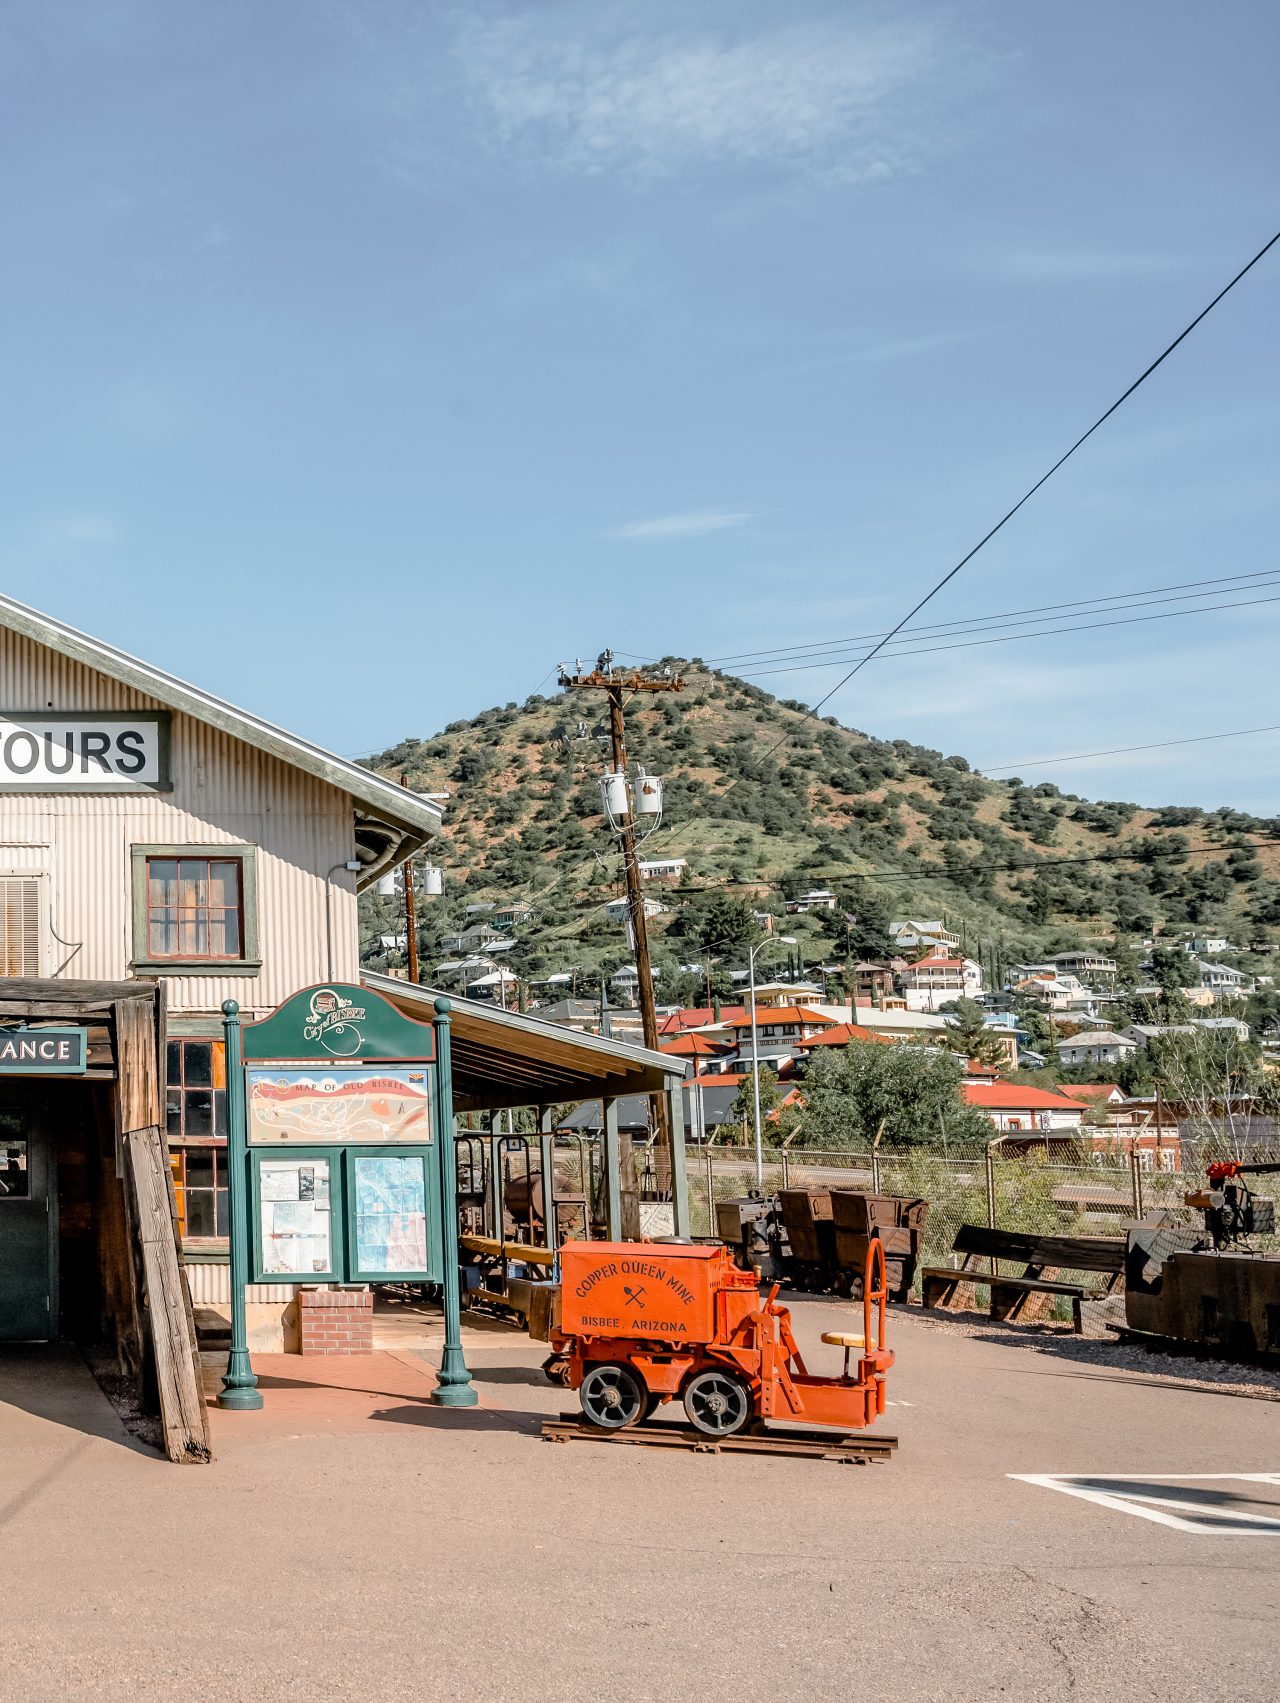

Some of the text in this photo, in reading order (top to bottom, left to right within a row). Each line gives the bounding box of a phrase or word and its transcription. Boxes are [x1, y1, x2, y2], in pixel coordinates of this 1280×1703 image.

[330, 1007, 366, 1024] BISBEE
[295, 1080, 404, 1092] MAP OF OLD BISBEE
[575, 1260, 695, 1305] COPPER QUEEN MINE
[631, 1319, 688, 1333] ARIZONA
